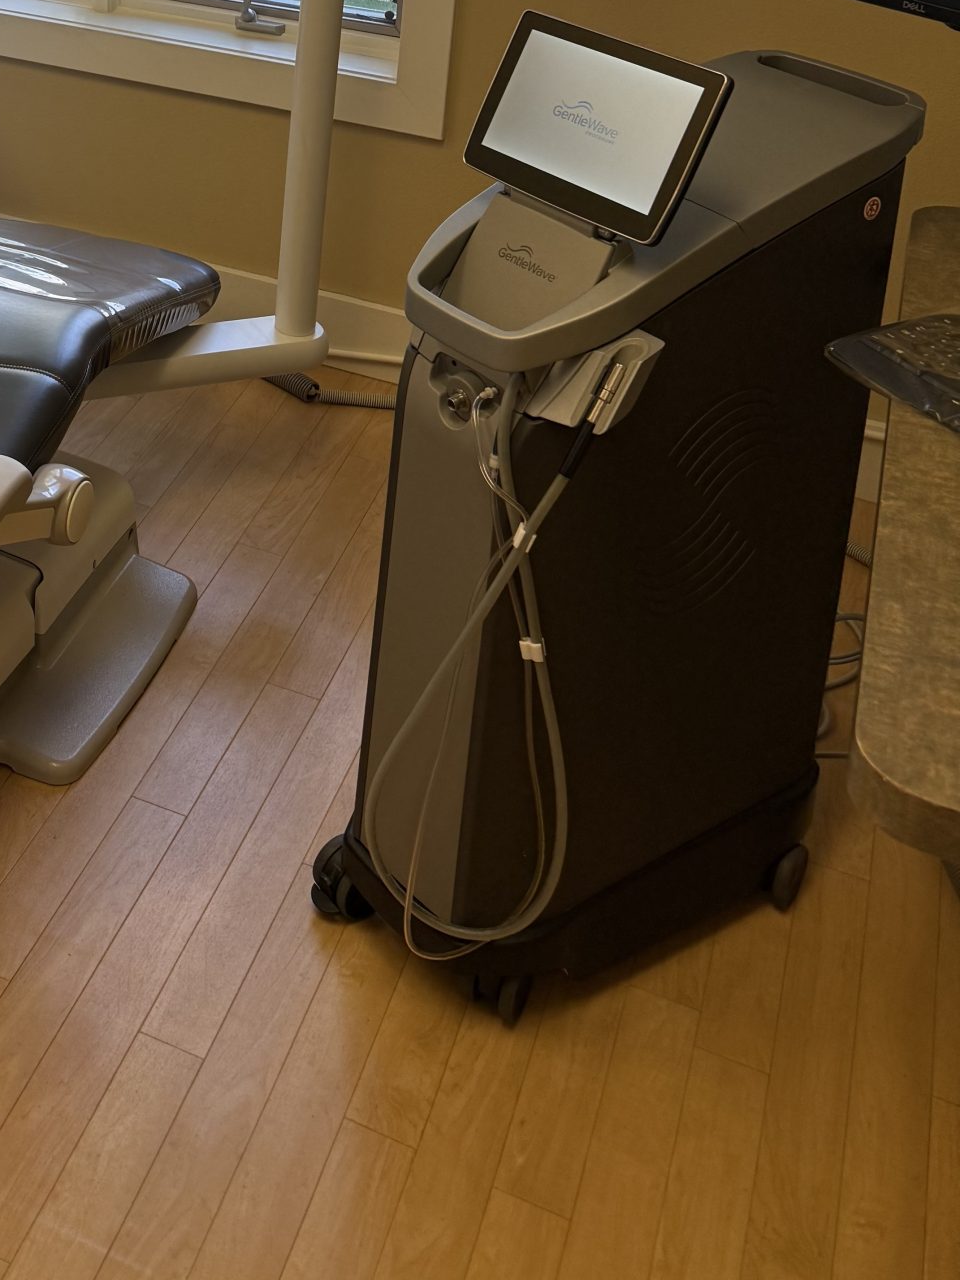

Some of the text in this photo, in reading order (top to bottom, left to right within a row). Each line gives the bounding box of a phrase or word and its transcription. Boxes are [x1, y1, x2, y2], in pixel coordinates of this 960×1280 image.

[902, 0, 925, 14] DELL
[552, 105, 618, 139] GentleWave
[498, 247, 556, 283] GentleWave
